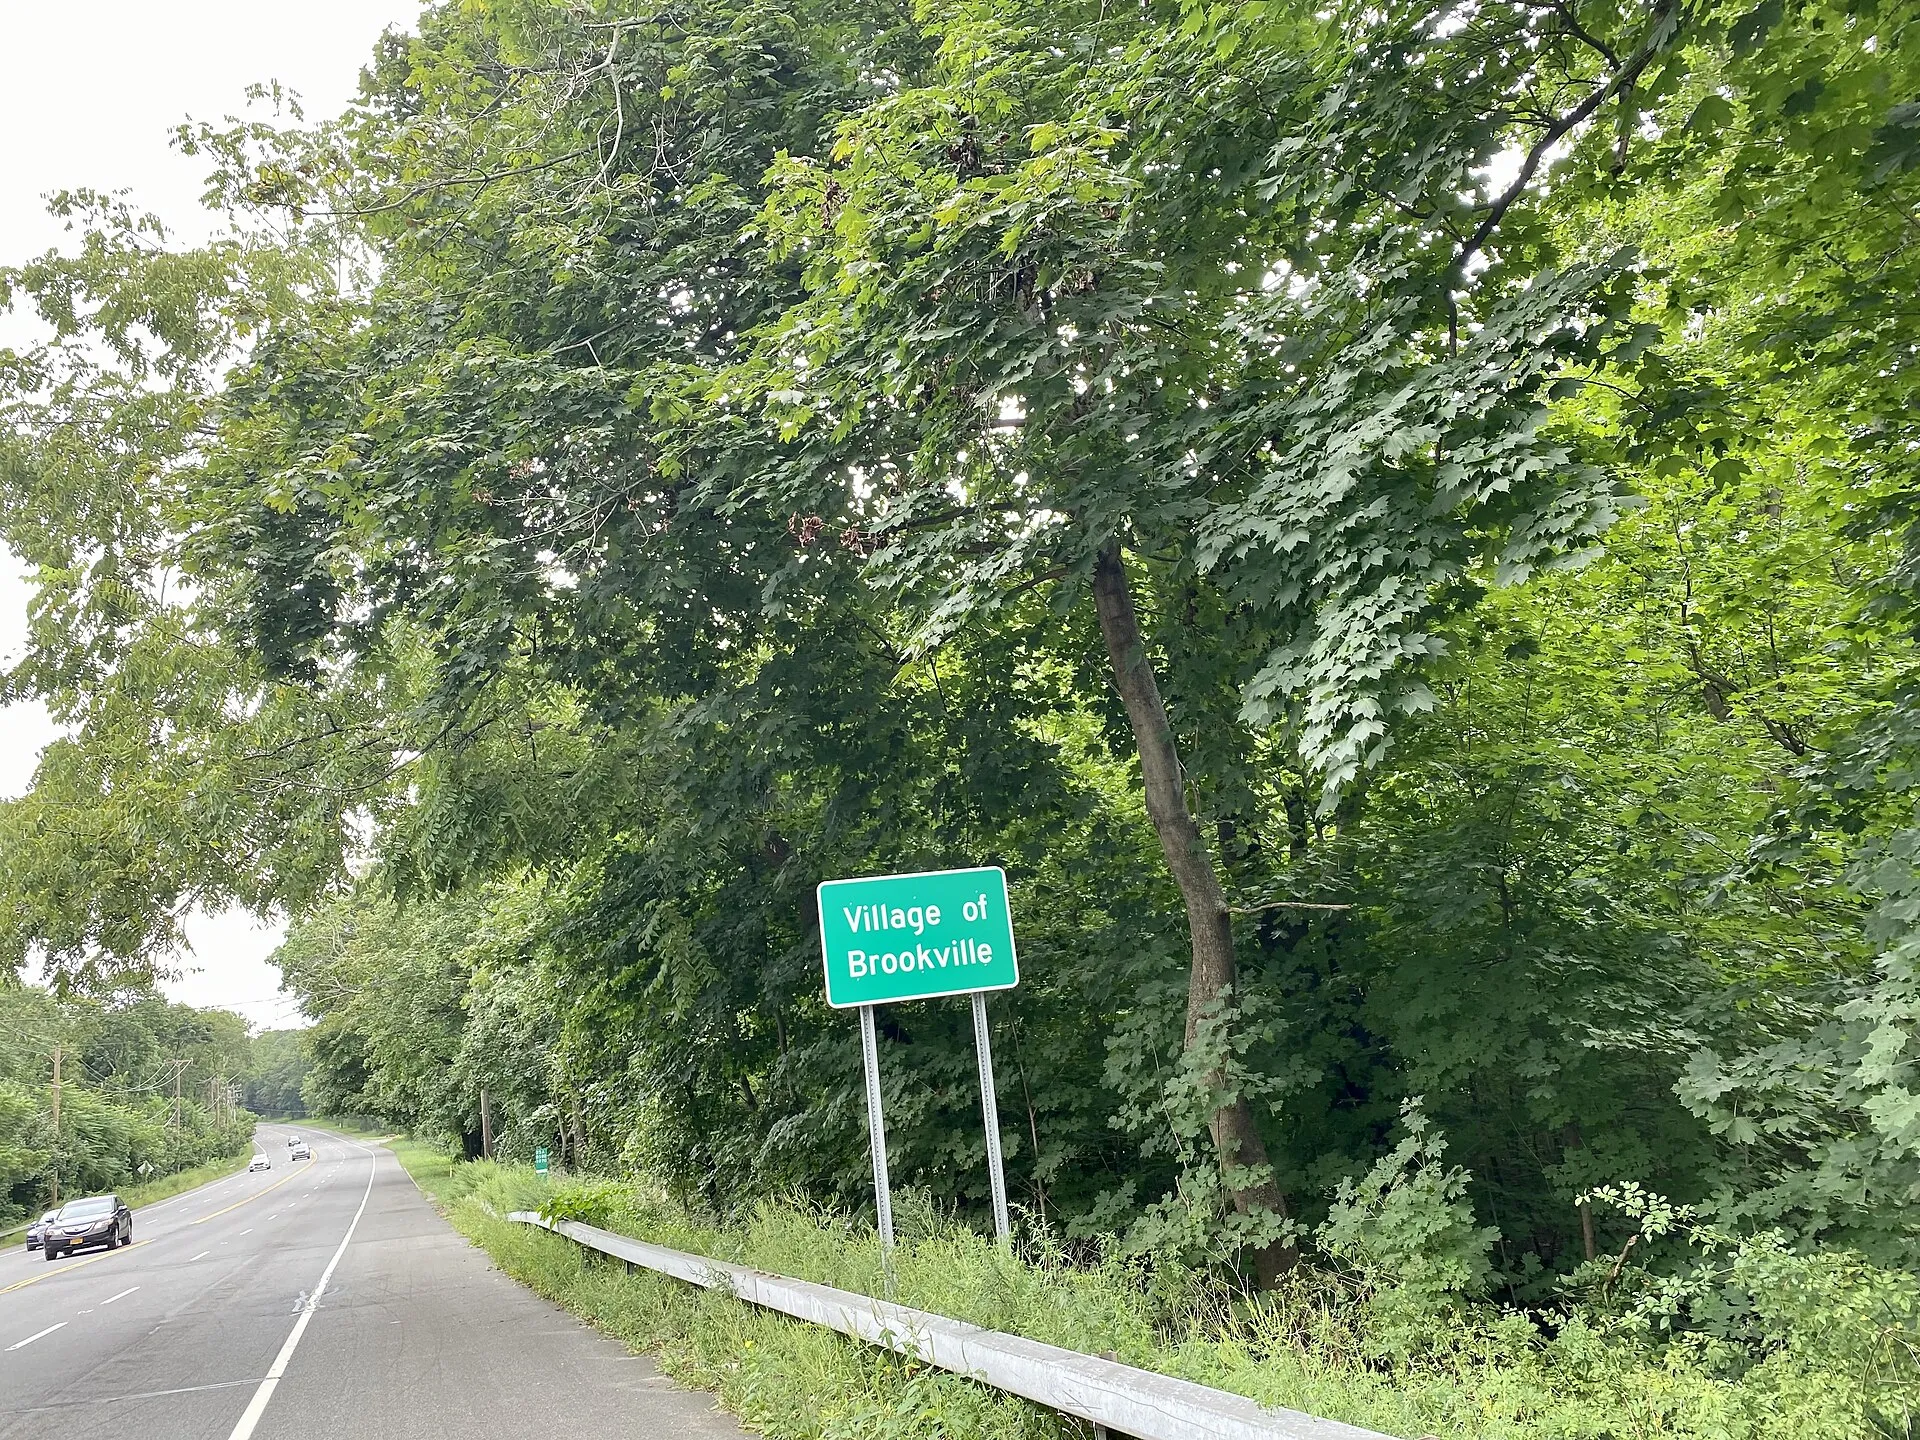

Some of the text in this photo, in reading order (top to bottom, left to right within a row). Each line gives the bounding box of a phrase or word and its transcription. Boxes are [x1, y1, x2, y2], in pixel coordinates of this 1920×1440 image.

[843, 893, 988, 936] Village of
[847, 937, 993, 978] Brookville
